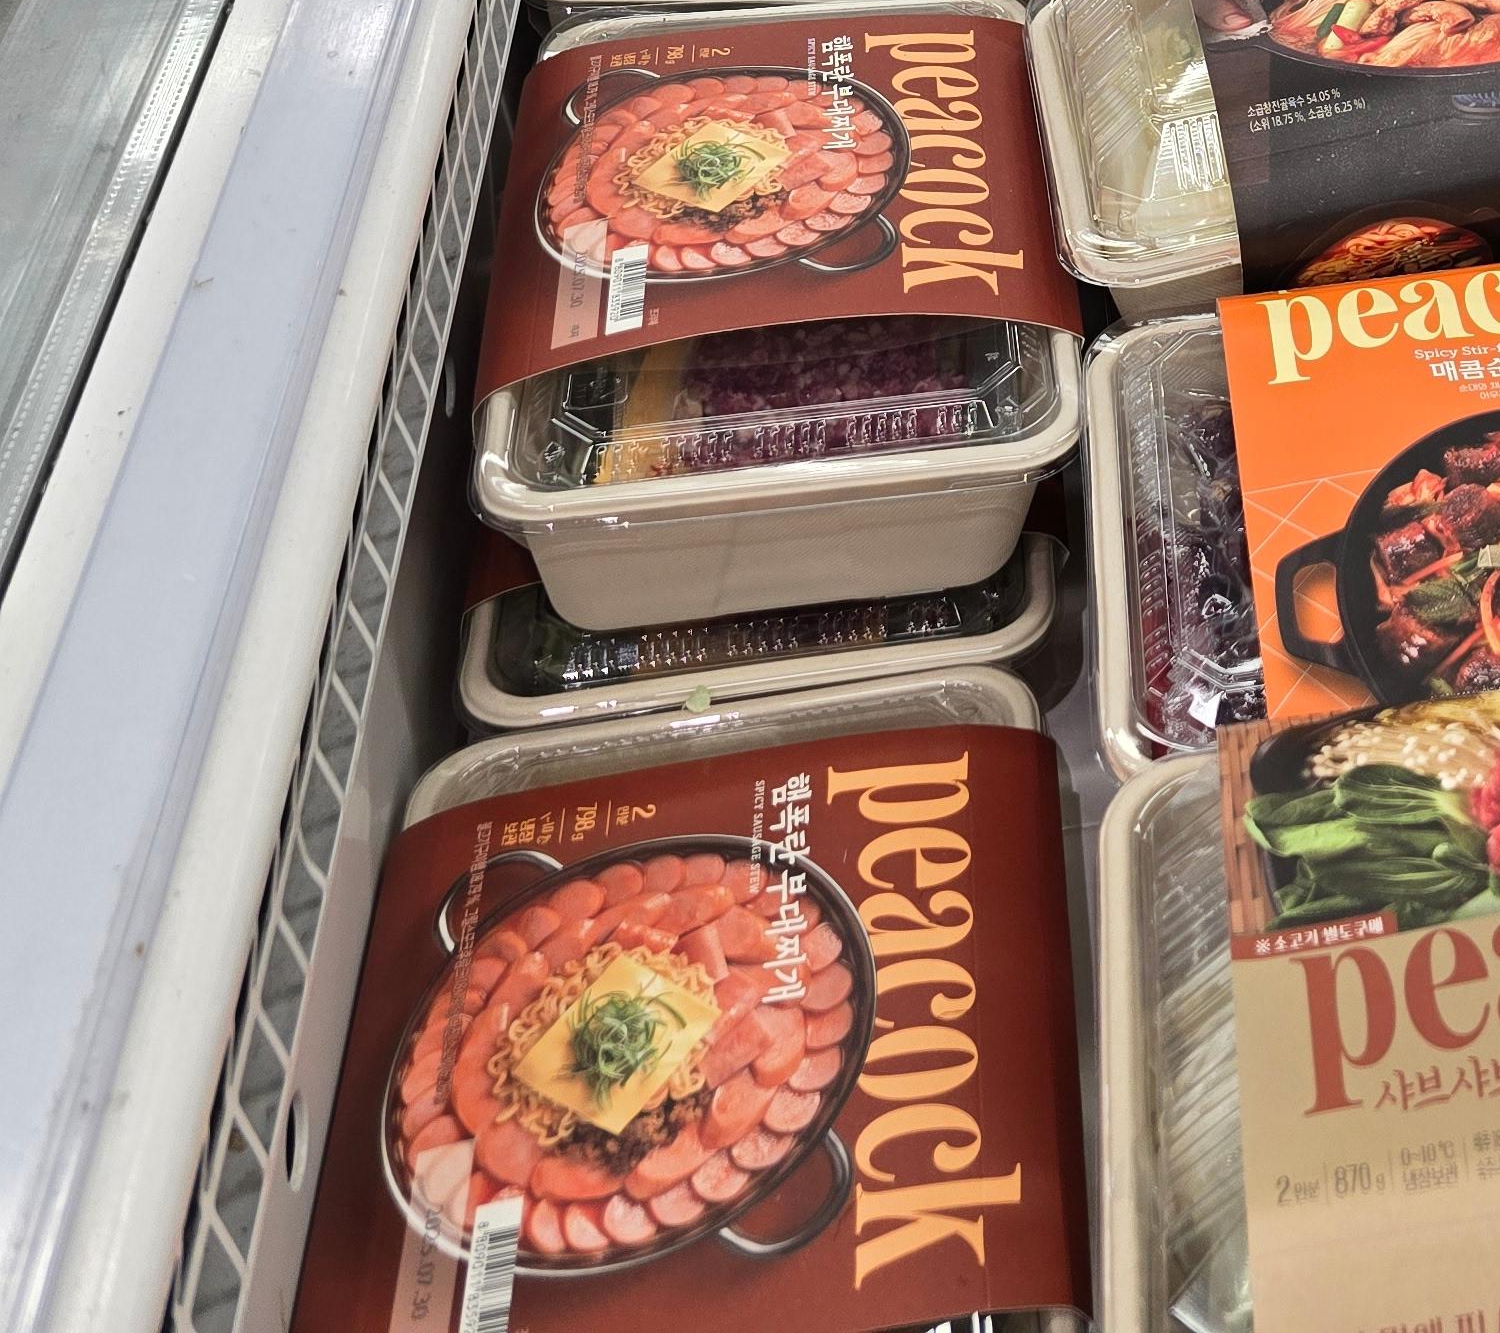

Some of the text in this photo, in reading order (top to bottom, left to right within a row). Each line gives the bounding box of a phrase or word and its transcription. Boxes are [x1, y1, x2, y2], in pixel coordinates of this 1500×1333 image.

[820, 35, 855, 151] 햄폭탄 부대찌개
[1247, 90, 1330, 118] 소곱창전골육수 54.05
[1250, 101, 1353, 133] (소위 18.75 소곱창 6.25
[864, 29, 1026, 296] peacock
[1414, 346, 1457, 361] Spicy
[575, 802, 599, 832] 798
[632, 803, 657, 821] 2
[747, 779, 766, 894] SPICY SAUSAGE STEW
[760, 772, 812, 1006] 햄폭탄 부대찌개
[1273, 917, 1384, 954] 소고기 별도구매
[826, 750, 1022, 1291] peacock
[1334, 1164, 1372, 1196] 870
[411, 1205, 446, 1321] 2025.07.30
